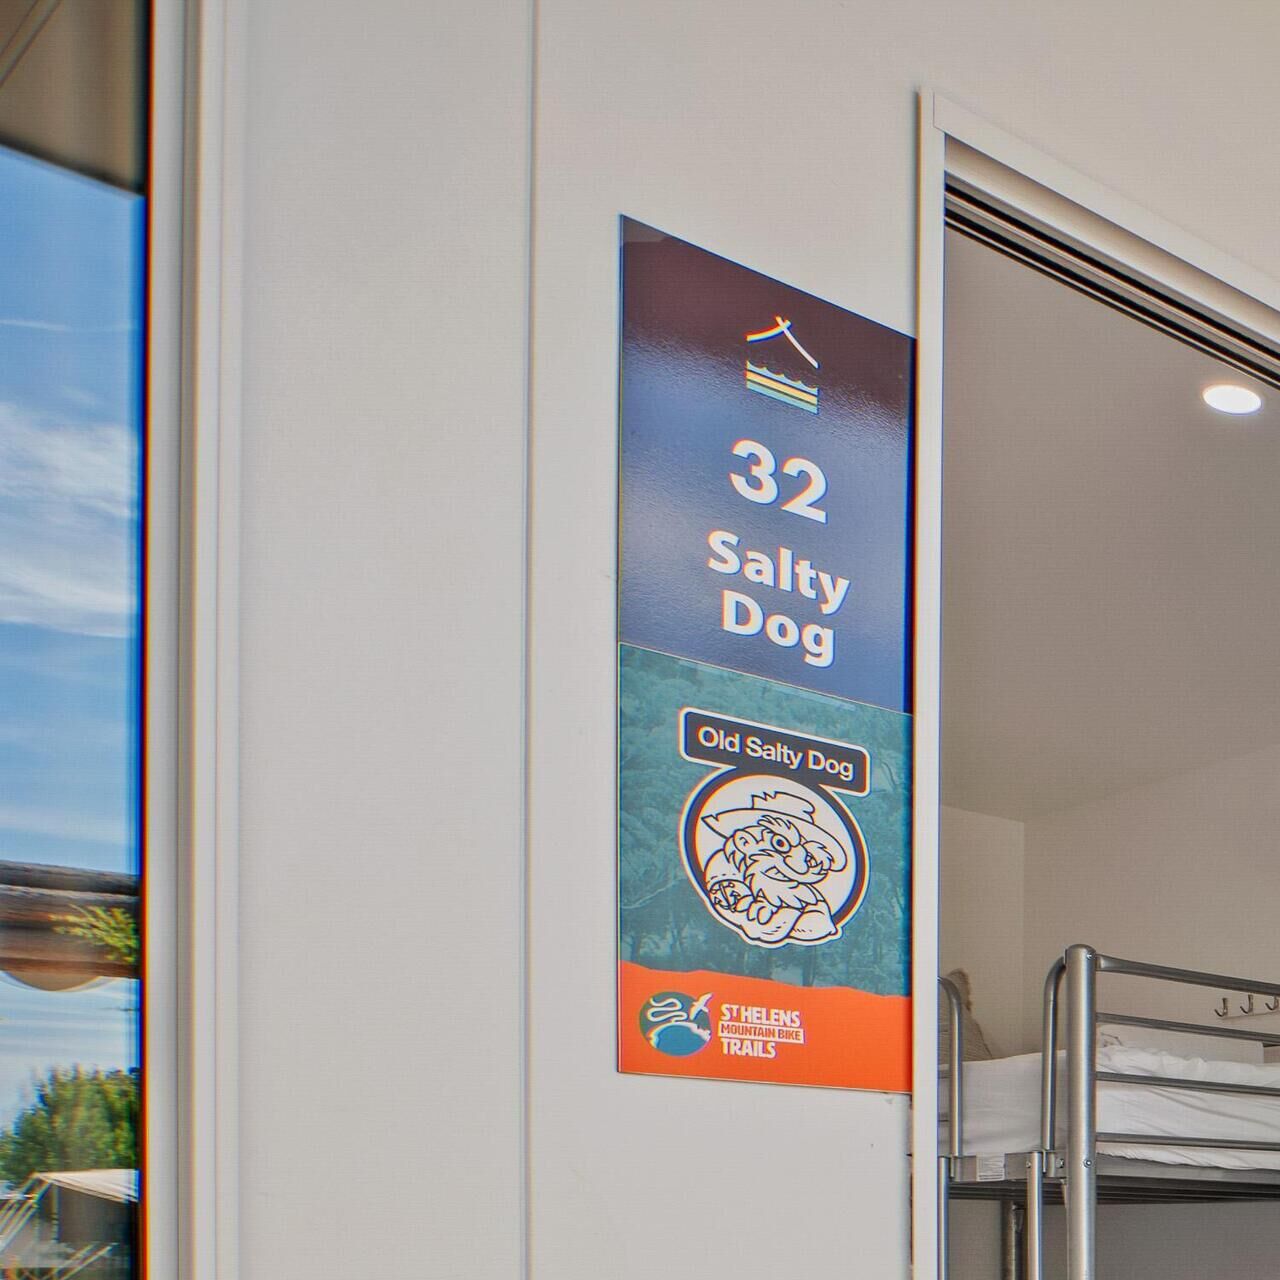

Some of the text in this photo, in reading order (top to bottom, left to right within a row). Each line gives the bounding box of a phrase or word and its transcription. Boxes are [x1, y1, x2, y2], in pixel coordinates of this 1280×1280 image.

[729, 439, 828, 524] 32
[706, 529, 850, 615] Salty
[720, 589, 836, 667] Dog
[698, 726, 856, 782] Old Salty Dog
[720, 1023, 801, 1041] MOUNTAIN BIKE
[740, 1005, 801, 1028] HELENS
[720, 1037, 777, 1059] TRAILS
